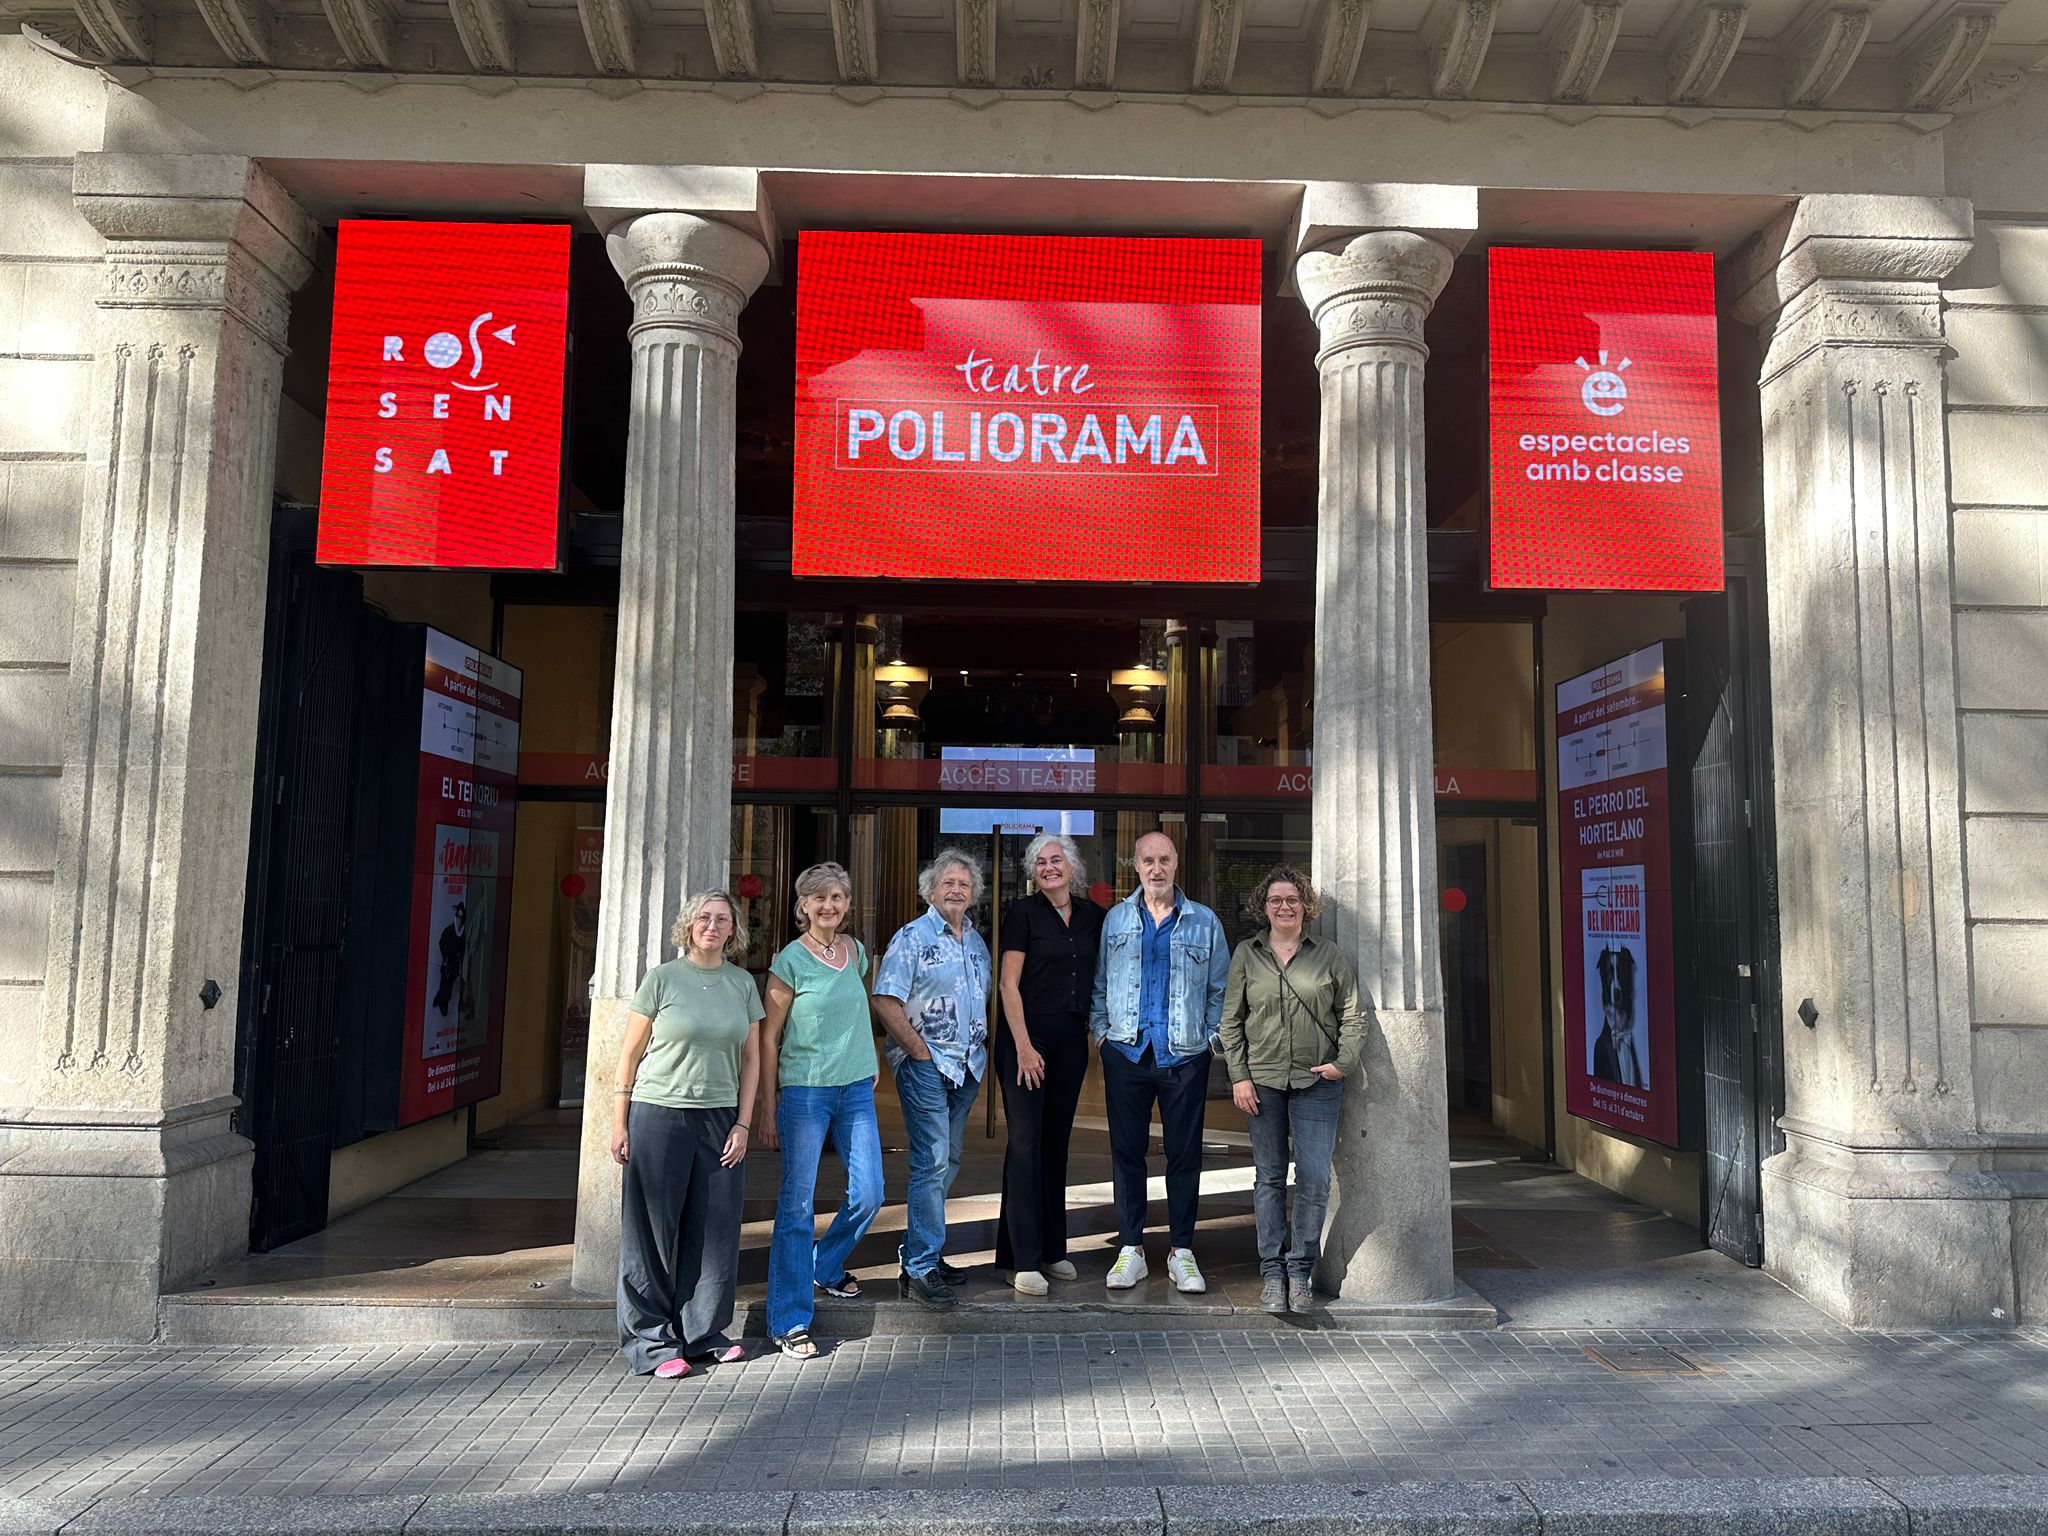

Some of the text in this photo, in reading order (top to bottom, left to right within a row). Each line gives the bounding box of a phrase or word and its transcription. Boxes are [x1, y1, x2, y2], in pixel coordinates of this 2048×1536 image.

[956, 348, 1095, 395] teatre
[848, 409, 1208, 466] POLIORAMA
[1519, 430, 1690, 457] espectacles
[1526, 459, 1684, 482] amb classe
[443, 675, 449, 688] A
[1573, 714, 1579, 725] A
[1595, 703, 1605, 717] del
[1017, 768, 1097, 787] TEATRE
[442, 776, 499, 806] EL TENORIU
[1574, 786, 1649, 818] EL PERRO DEL
[1579, 817, 1644, 846] HORTELANO
[1615, 884, 1640, 908] PERRO
[1587, 910, 1641, 932] DEL HORTELANO
